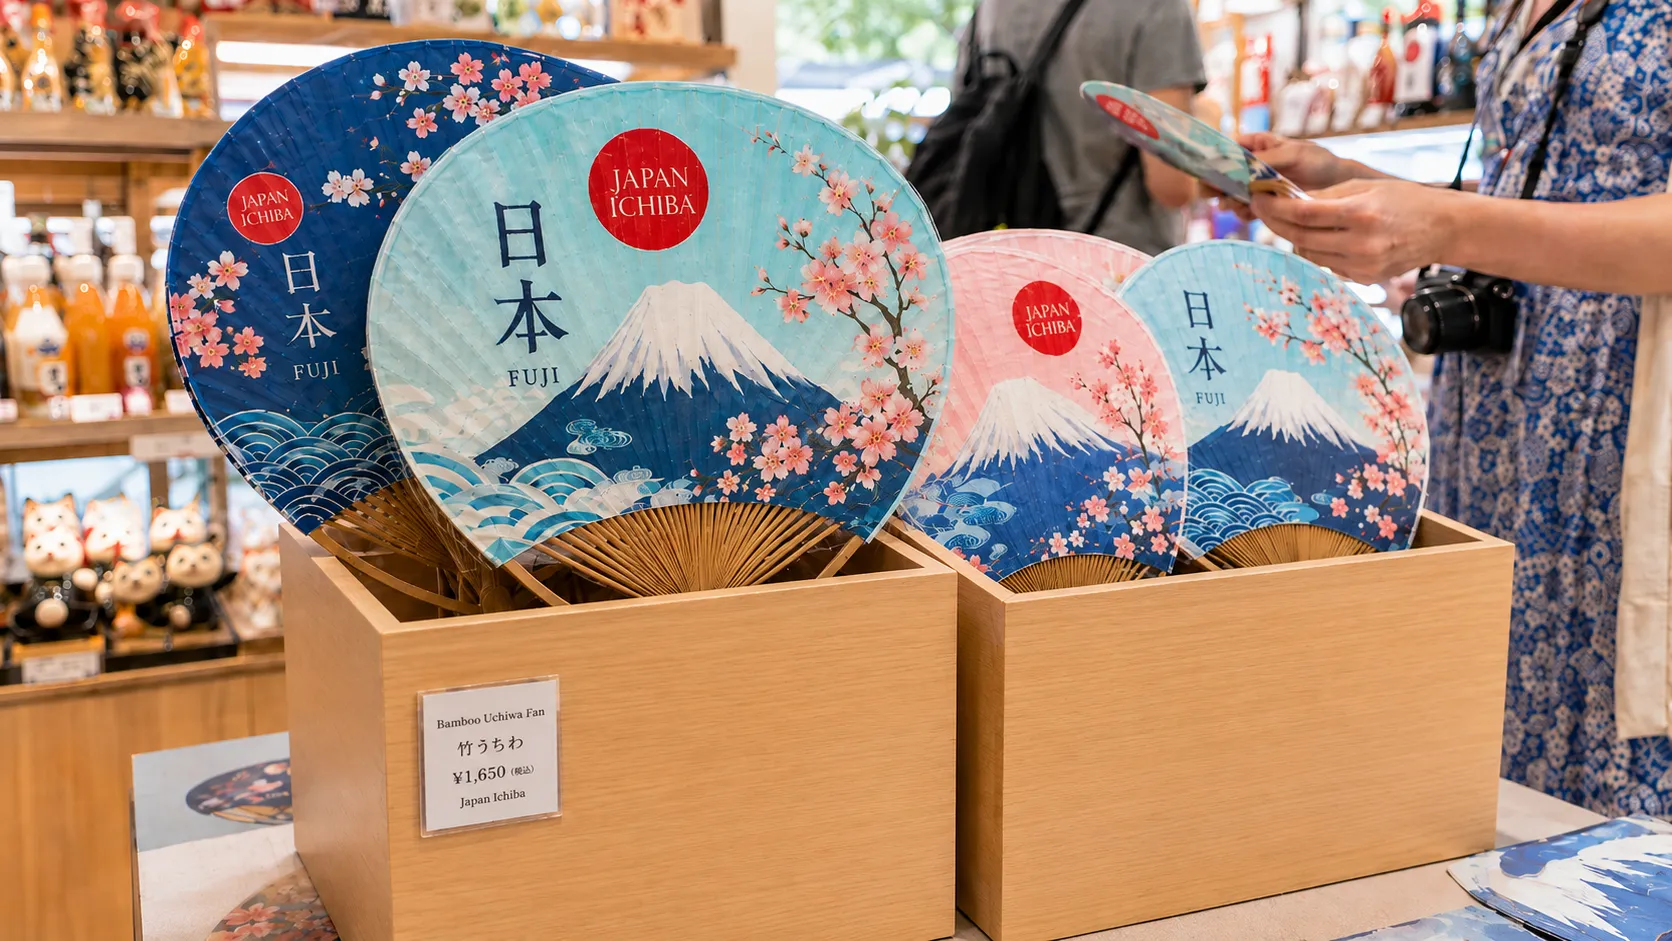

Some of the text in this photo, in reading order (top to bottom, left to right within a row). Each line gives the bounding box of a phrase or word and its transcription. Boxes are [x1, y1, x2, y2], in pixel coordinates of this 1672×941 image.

[612, 166, 689, 195] JAPAN
[241, 189, 290, 212] JAPAN
[610, 195, 697, 218] ICHIBA
[240, 207, 295, 227] ICHIBA
[493, 199, 570, 354] 日本
[282, 250, 338, 349] 日本
[1025, 302, 1071, 322] JAPAN
[1026, 320, 1077, 339] ICHIBA
[1183, 290, 1227, 381] 日本
[293, 360, 341, 381] FUJI
[507, 366, 560, 388] FUJI
[1195, 392, 1225, 406] FUJI
[437, 708, 546, 729] Bamboo Uchiwa Fan
[457, 735, 524, 757] 竹うちわ
[453, 765, 506, 785] ¥1,650
[460, 789, 526, 809] Japan Ichiba
